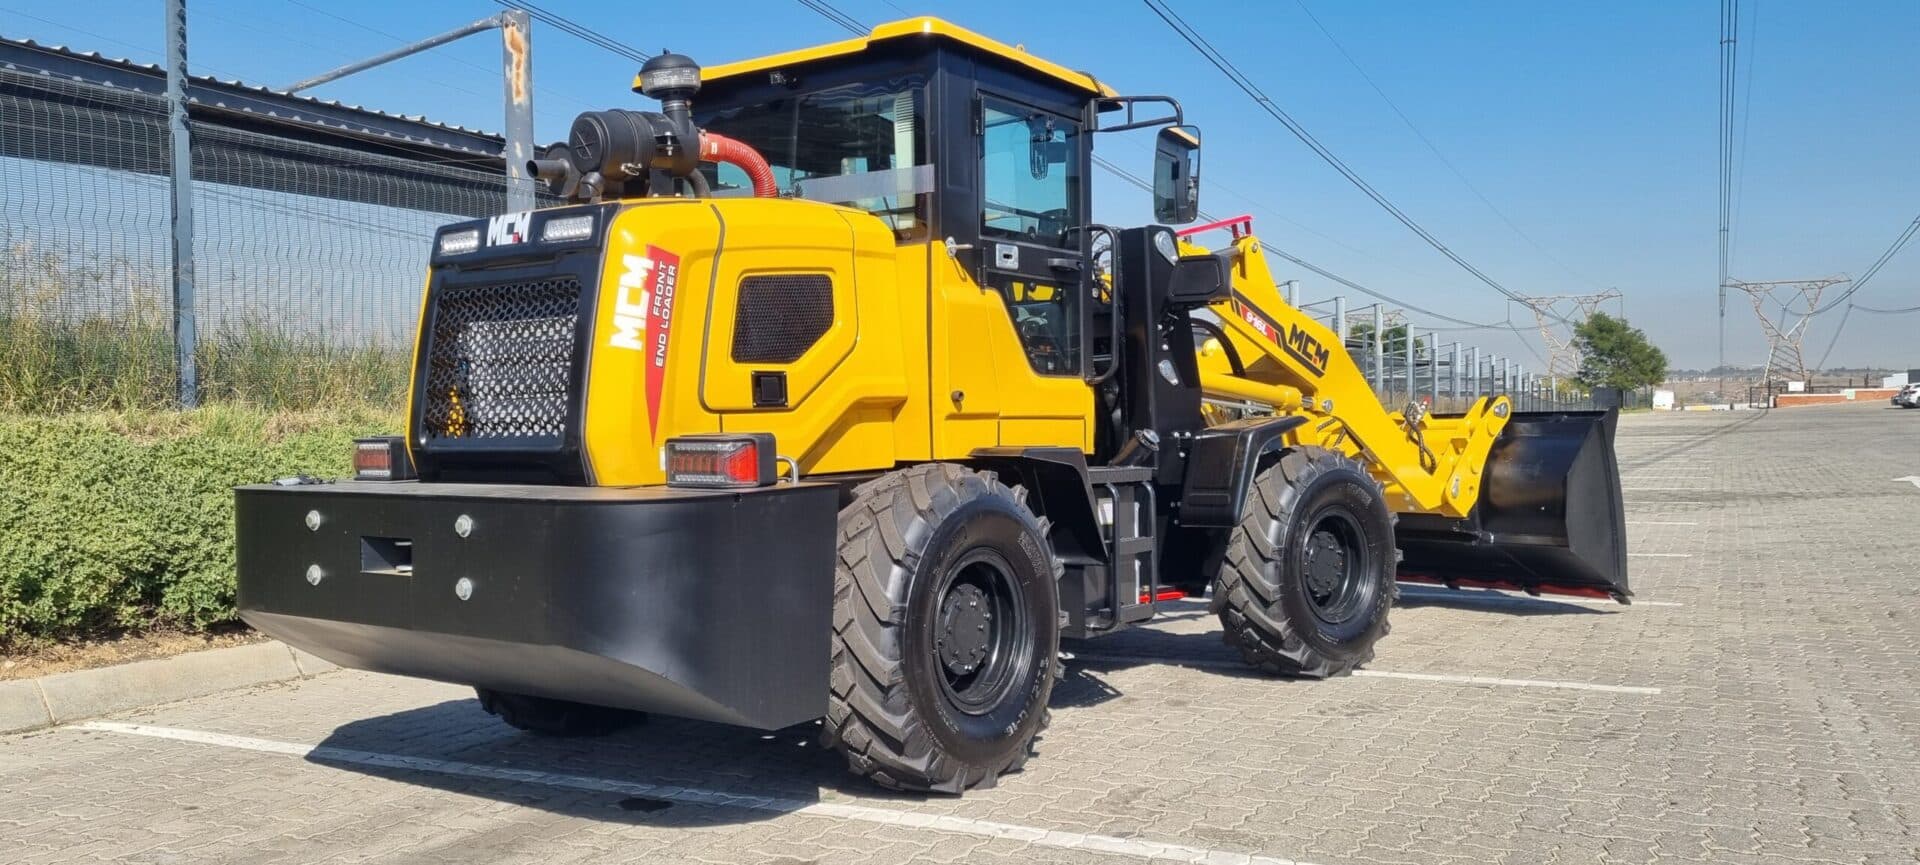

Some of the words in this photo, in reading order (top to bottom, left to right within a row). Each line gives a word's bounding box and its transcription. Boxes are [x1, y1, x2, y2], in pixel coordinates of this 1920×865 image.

[486, 210, 532, 247] MCM
[609, 253, 655, 351] MCM
[652, 260, 667, 316] FRONT
[655, 333, 667, 367] END
[661, 264, 677, 329] LOADER
[1288, 322, 1330, 371] MCM
